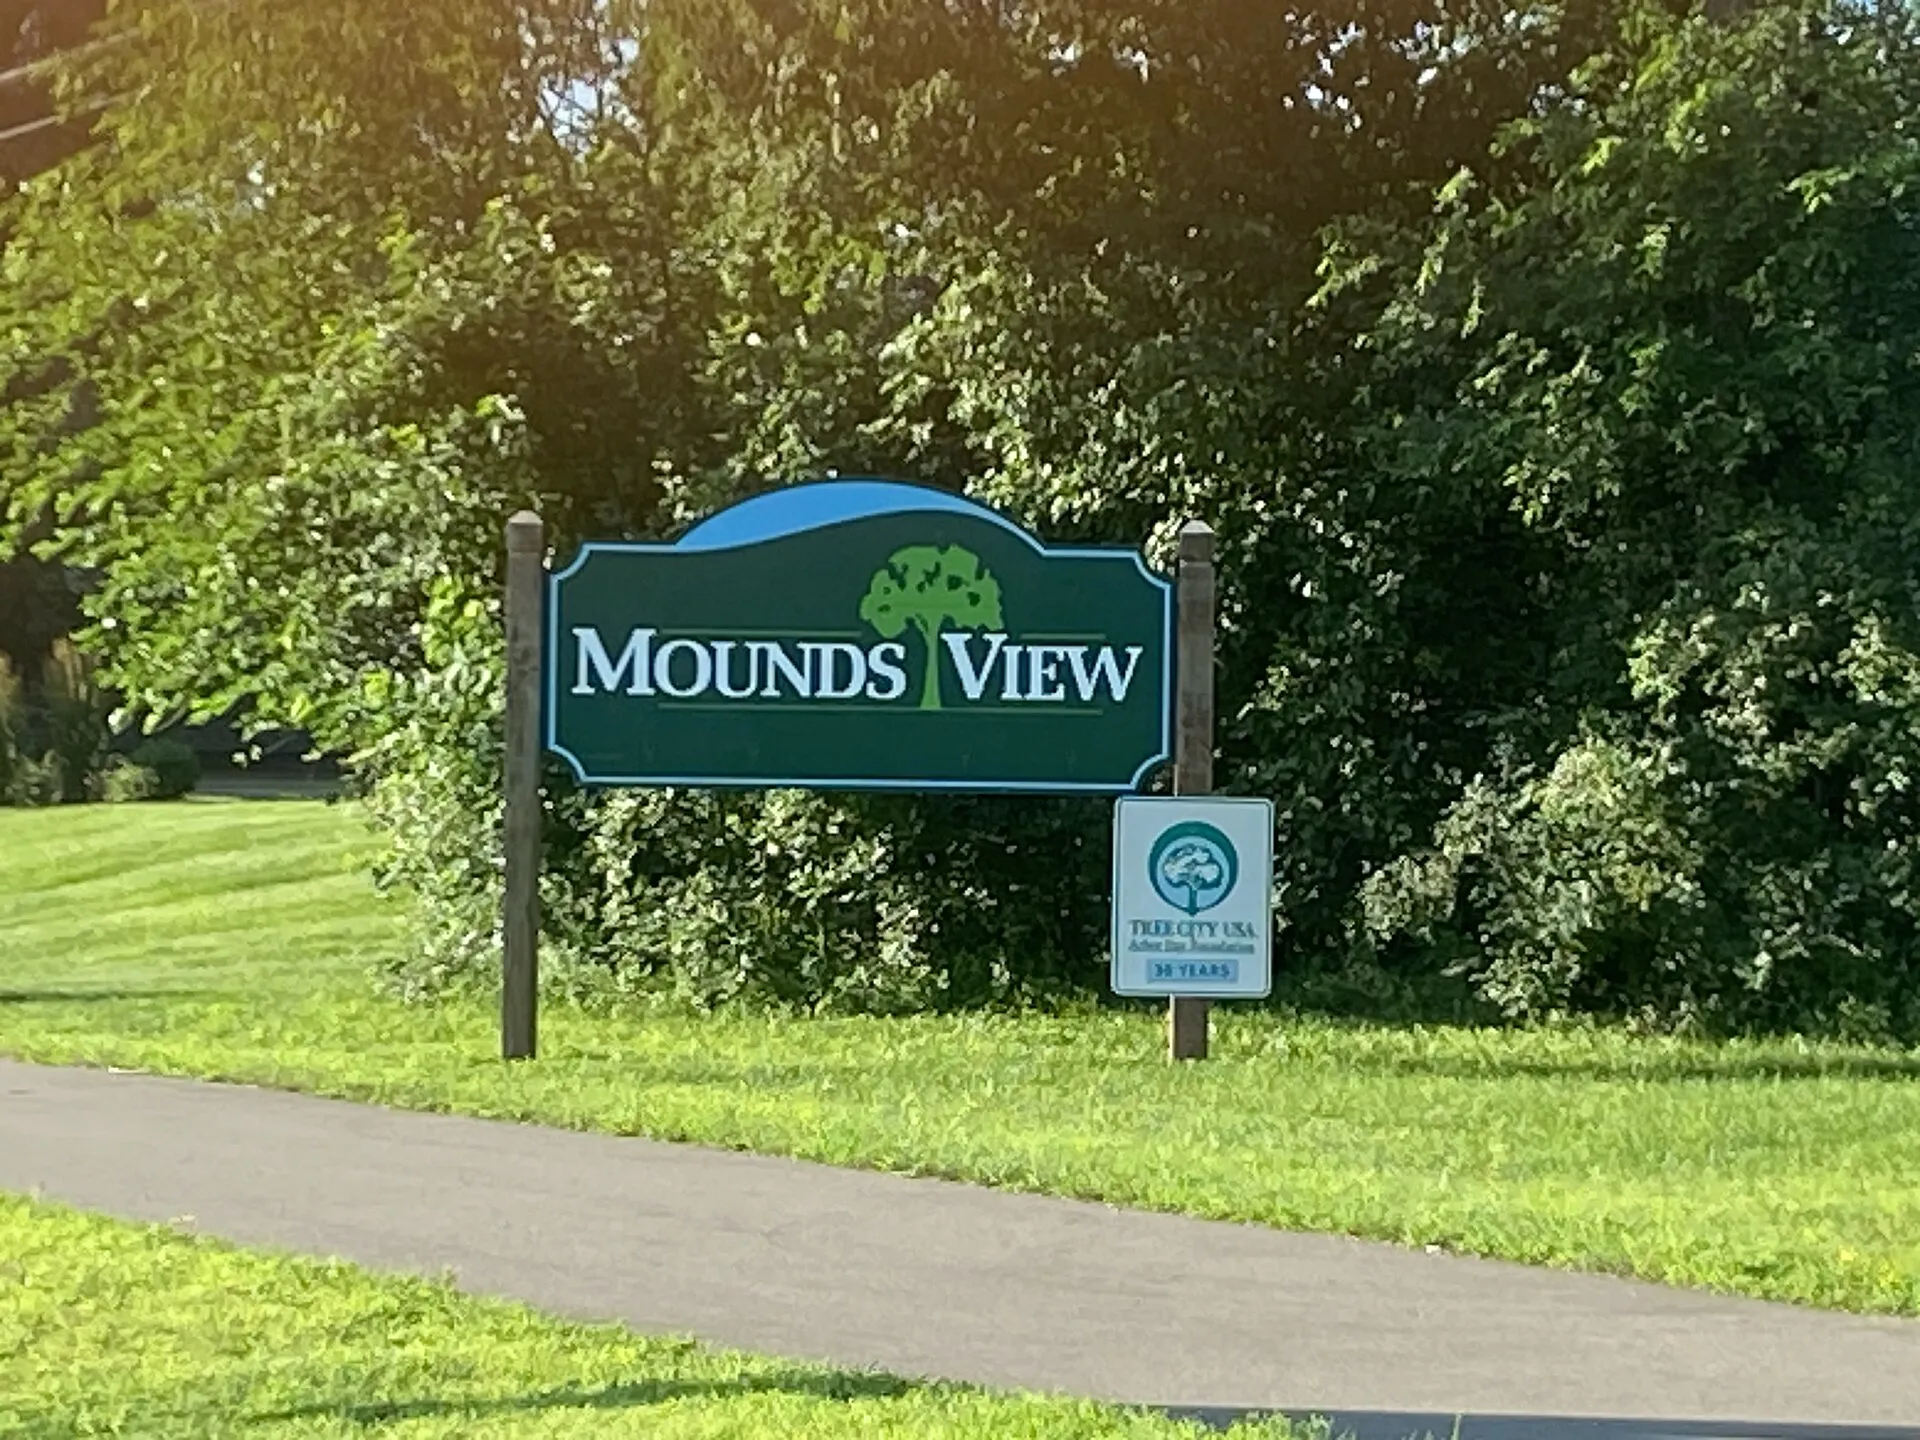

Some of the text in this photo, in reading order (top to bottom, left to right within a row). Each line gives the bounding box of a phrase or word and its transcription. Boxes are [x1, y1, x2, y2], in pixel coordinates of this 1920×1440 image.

[571, 627, 1143, 702] MOUNDS VIEW
[1128, 919, 1259, 938] TREE CITY USA
[1179, 963, 1230, 978] YEARS
